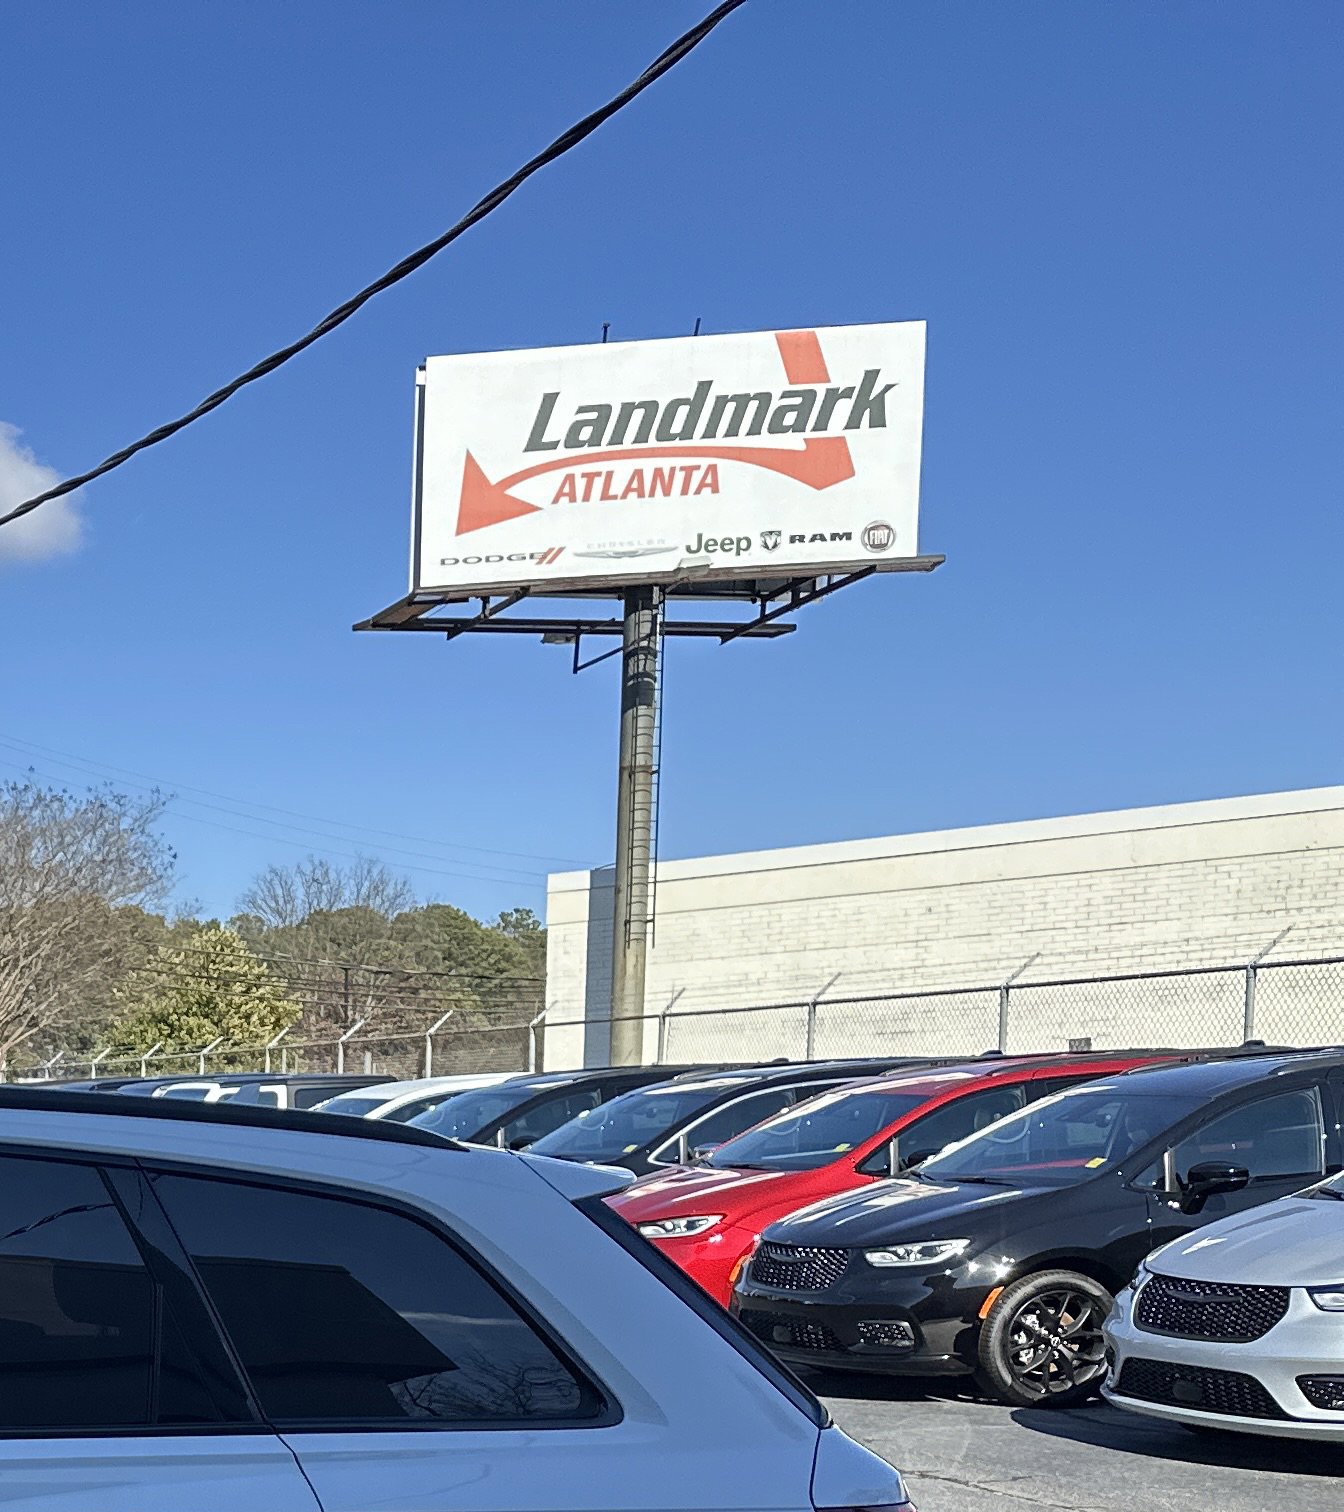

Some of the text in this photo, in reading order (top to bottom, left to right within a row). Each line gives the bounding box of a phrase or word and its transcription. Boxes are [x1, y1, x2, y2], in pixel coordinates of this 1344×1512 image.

[522, 368, 900, 453] Landmark
[551, 463, 720, 505] ATLANTA
[440, 551, 548, 566] DODGE
[685, 532, 752, 556] Jeep
[789, 531, 853, 544] RAM
[869, 529, 889, 546] FIAT
